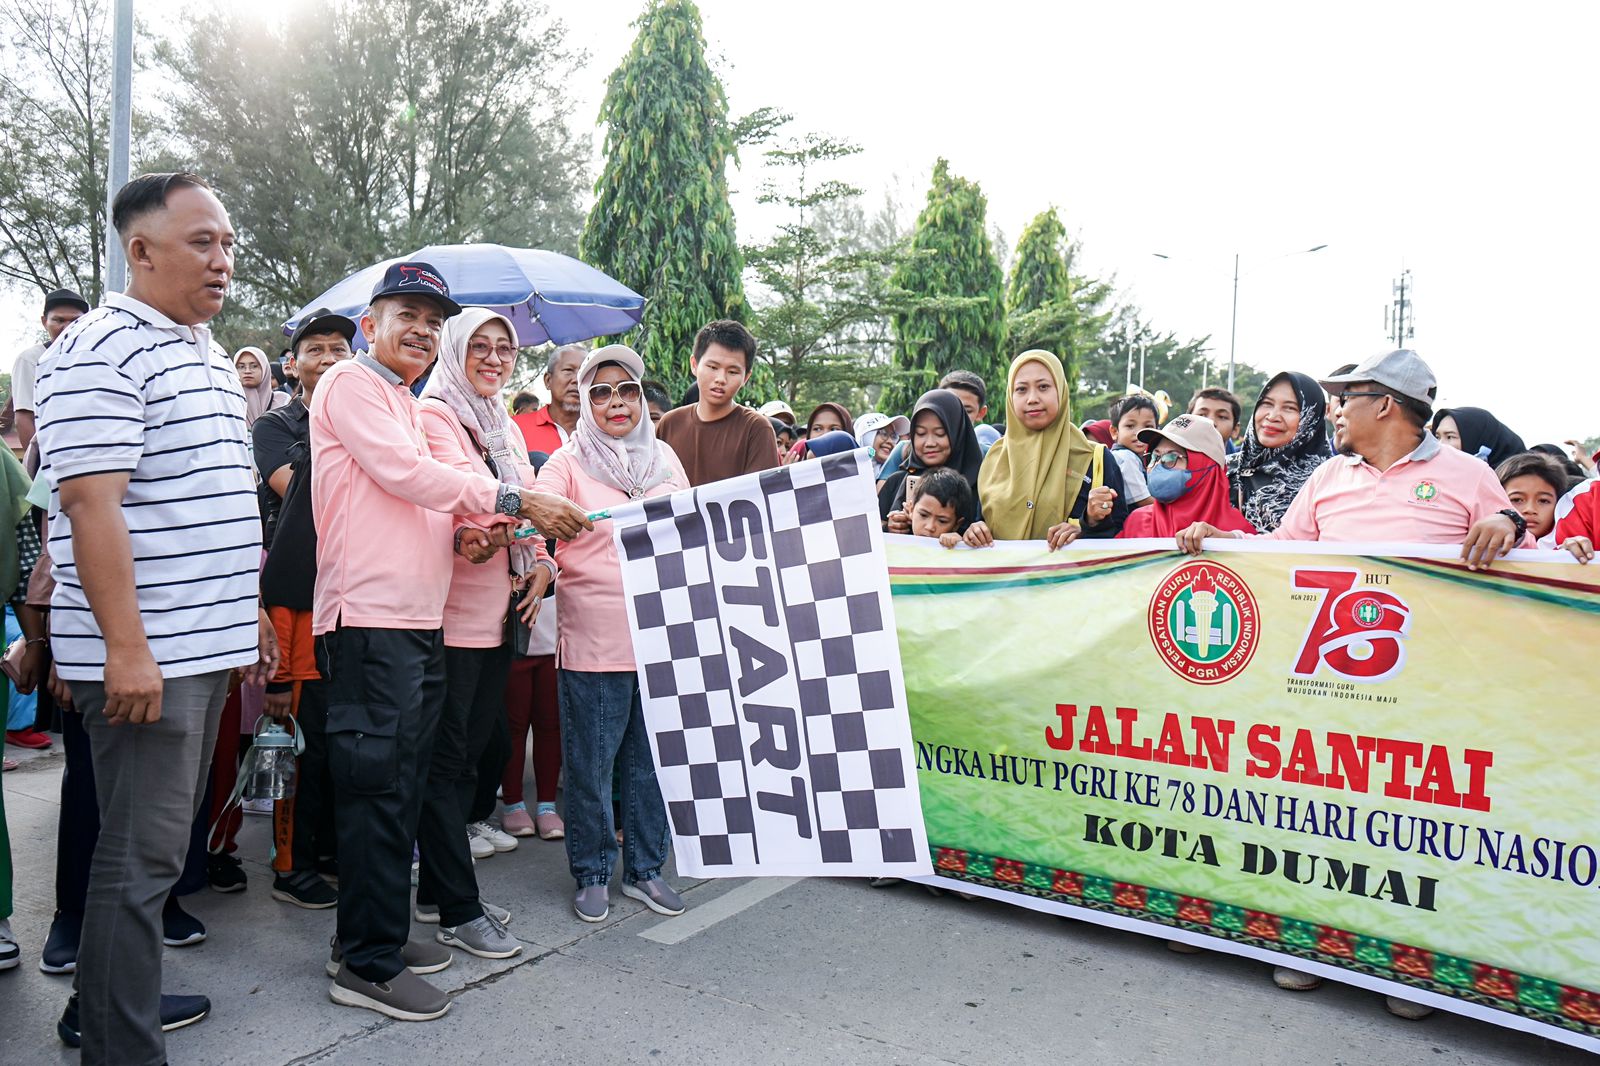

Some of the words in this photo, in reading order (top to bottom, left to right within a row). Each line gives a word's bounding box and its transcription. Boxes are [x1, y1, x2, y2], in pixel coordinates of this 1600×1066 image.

[1163, 571, 1191, 598] GURU
[1216, 572, 1252, 618] REPUBLIK
[1365, 573, 1391, 585] HUT
[1155, 599, 1186, 668] PERSATUAN
[1221, 621, 1252, 671] INDONESIA
[706, 499, 812, 840] START
[1187, 666, 1219, 678] PGRI
[1287, 678, 1335, 689] TRANSFORMASI
[1336, 683, 1355, 691] GURU
[1287, 687, 1327, 697] WUJUDKAN
[1330, 691, 1373, 701] INDONESIA
[1376, 695, 1398, 704] MAJU
[1045, 703, 1235, 773] JALAN
[1246, 723, 1493, 813] SANTAI
[916, 741, 986, 779] NGKA
[990, 753, 1047, 788] HUT
[1052, 761, 1117, 800] PGRI
[1124, 771, 1160, 807] KE
[1167, 779, 1196, 813] 78
[1202, 784, 1269, 826] DAN
[1274, 795, 1358, 842] HARI
[1365, 810, 1469, 861] GURU
[1474, 827, 1600, 889] NASIO
[1082, 813, 1221, 867] KOTA
[1240, 841, 1440, 912] DUMAI
